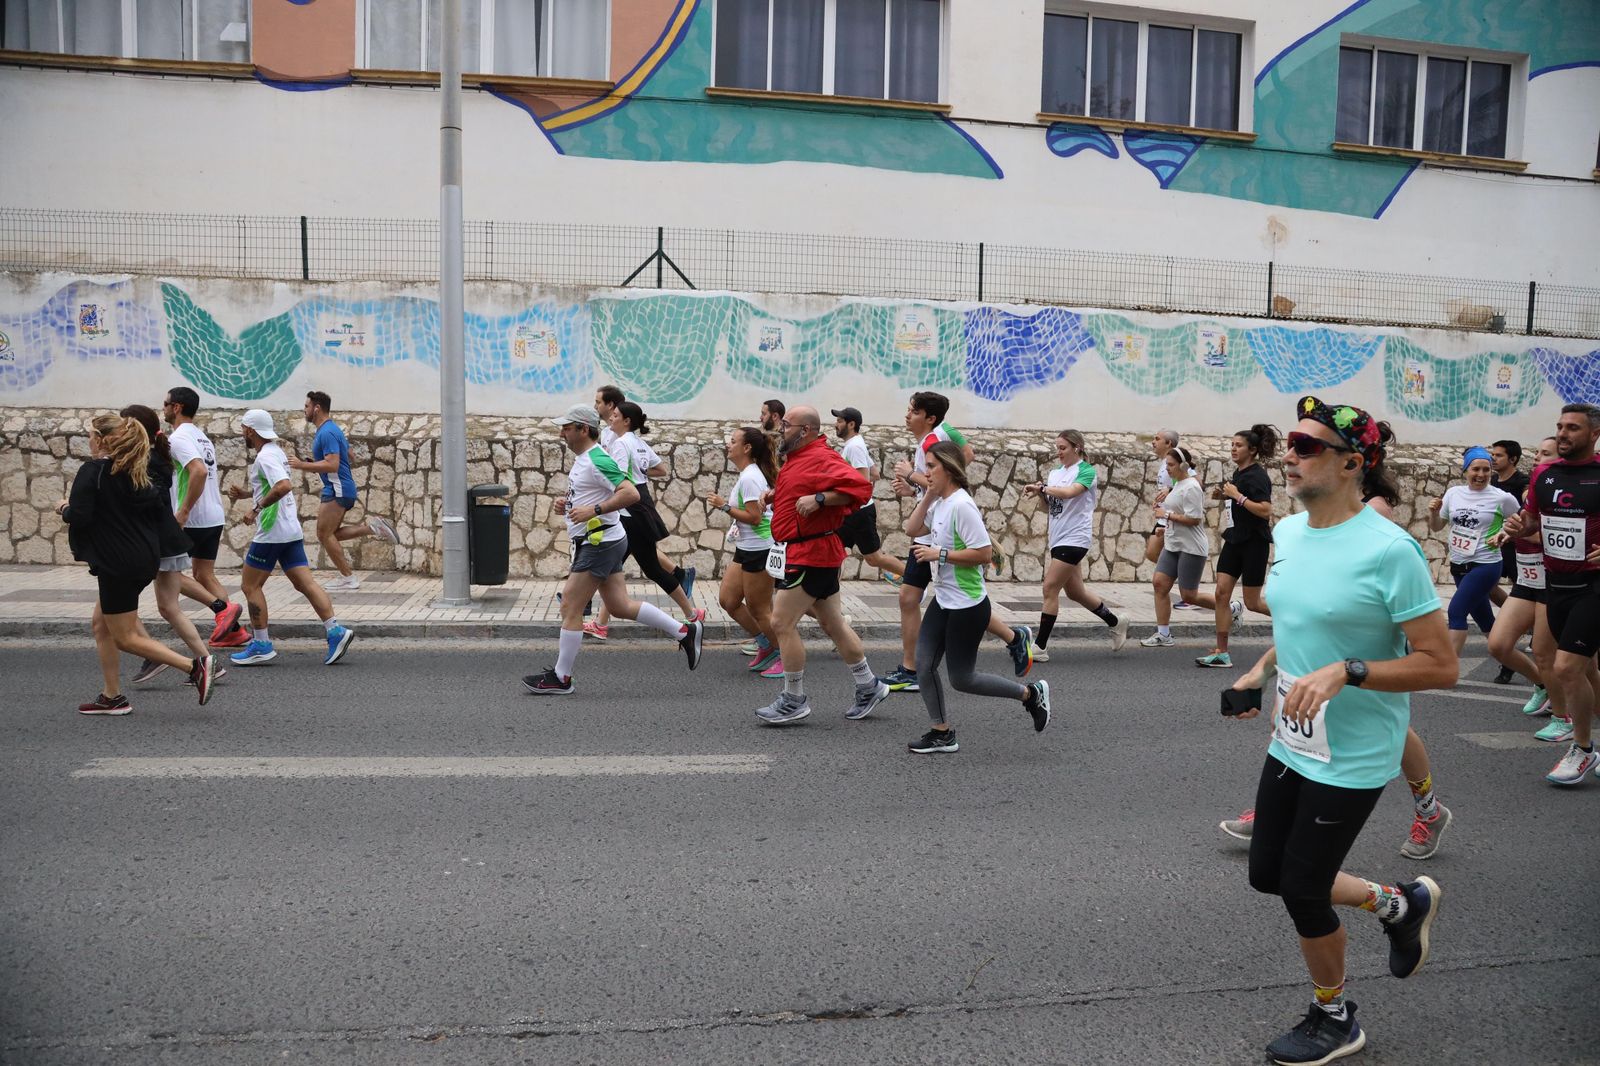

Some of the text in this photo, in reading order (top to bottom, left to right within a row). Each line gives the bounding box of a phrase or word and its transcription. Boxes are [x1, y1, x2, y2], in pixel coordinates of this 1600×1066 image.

[1452, 537, 1471, 550] 312
[1547, 532, 1576, 549] 660
[770, 556, 782, 569] 800
[1521, 567, 1538, 580] 35
